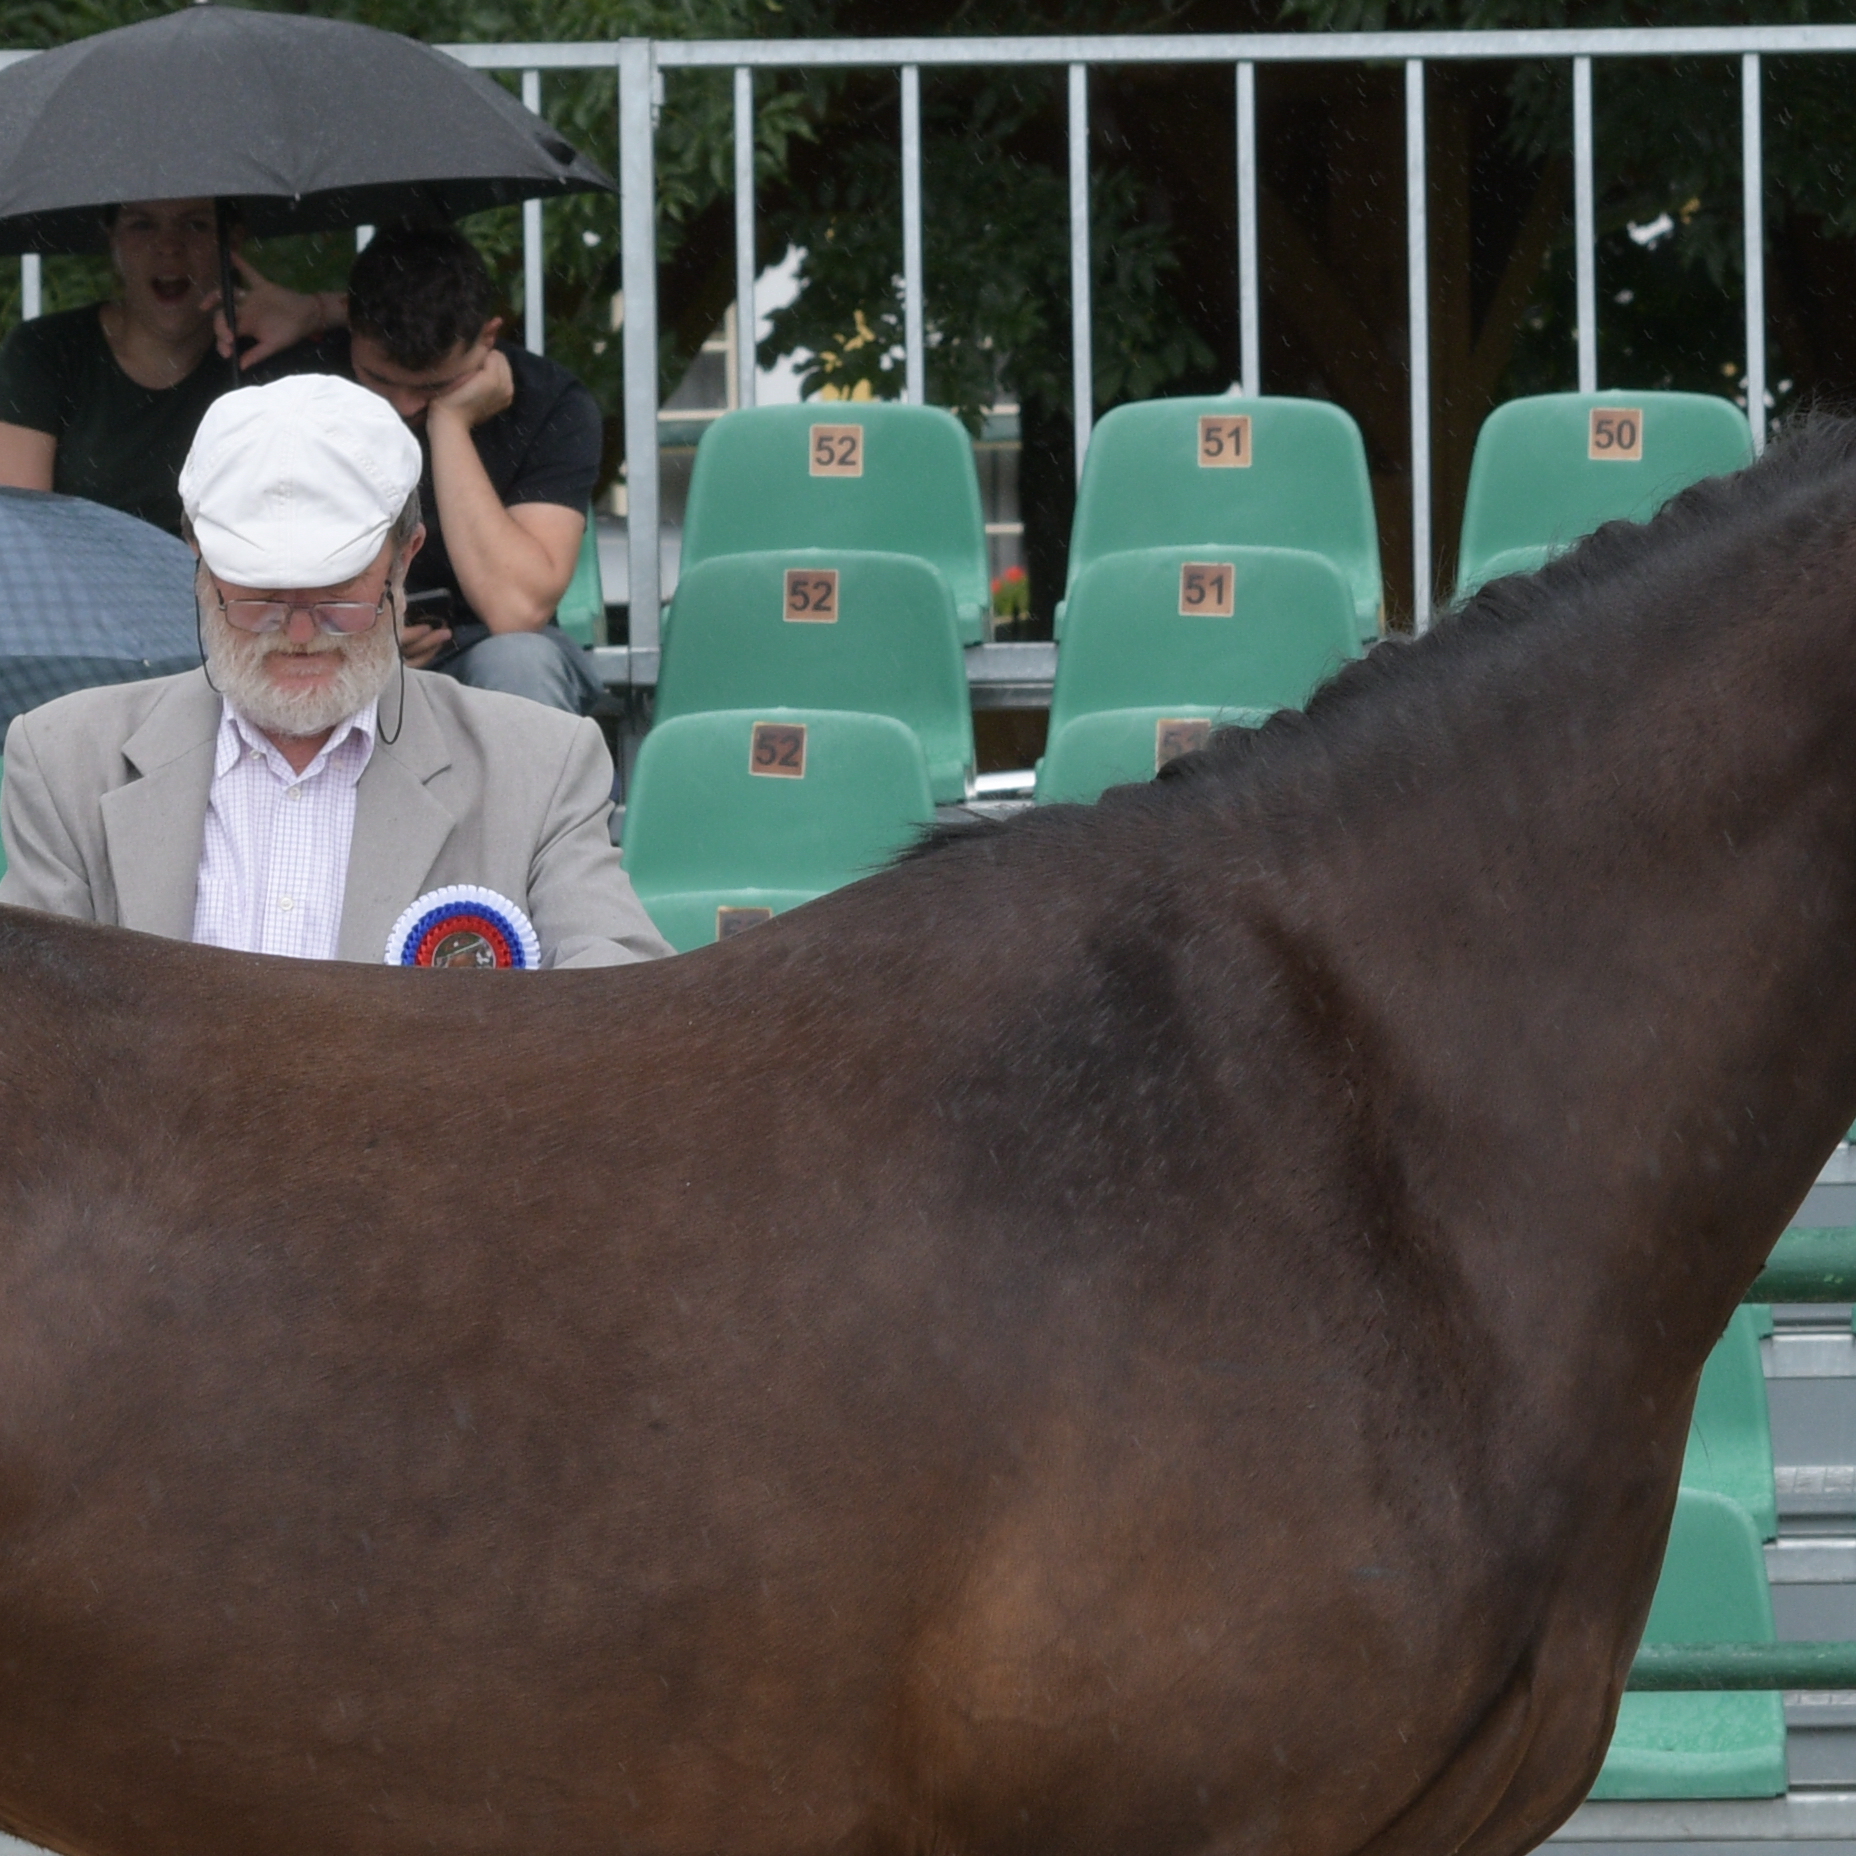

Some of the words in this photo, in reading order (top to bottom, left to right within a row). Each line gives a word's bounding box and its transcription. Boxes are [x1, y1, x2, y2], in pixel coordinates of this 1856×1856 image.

[1204, 426, 1241, 457] 51
[1594, 419, 1636, 450] 50
[815, 435, 857, 466] 52
[789, 580, 832, 612] 52
[1185, 574, 1224, 606] 51
[754, 733, 800, 768] 52
